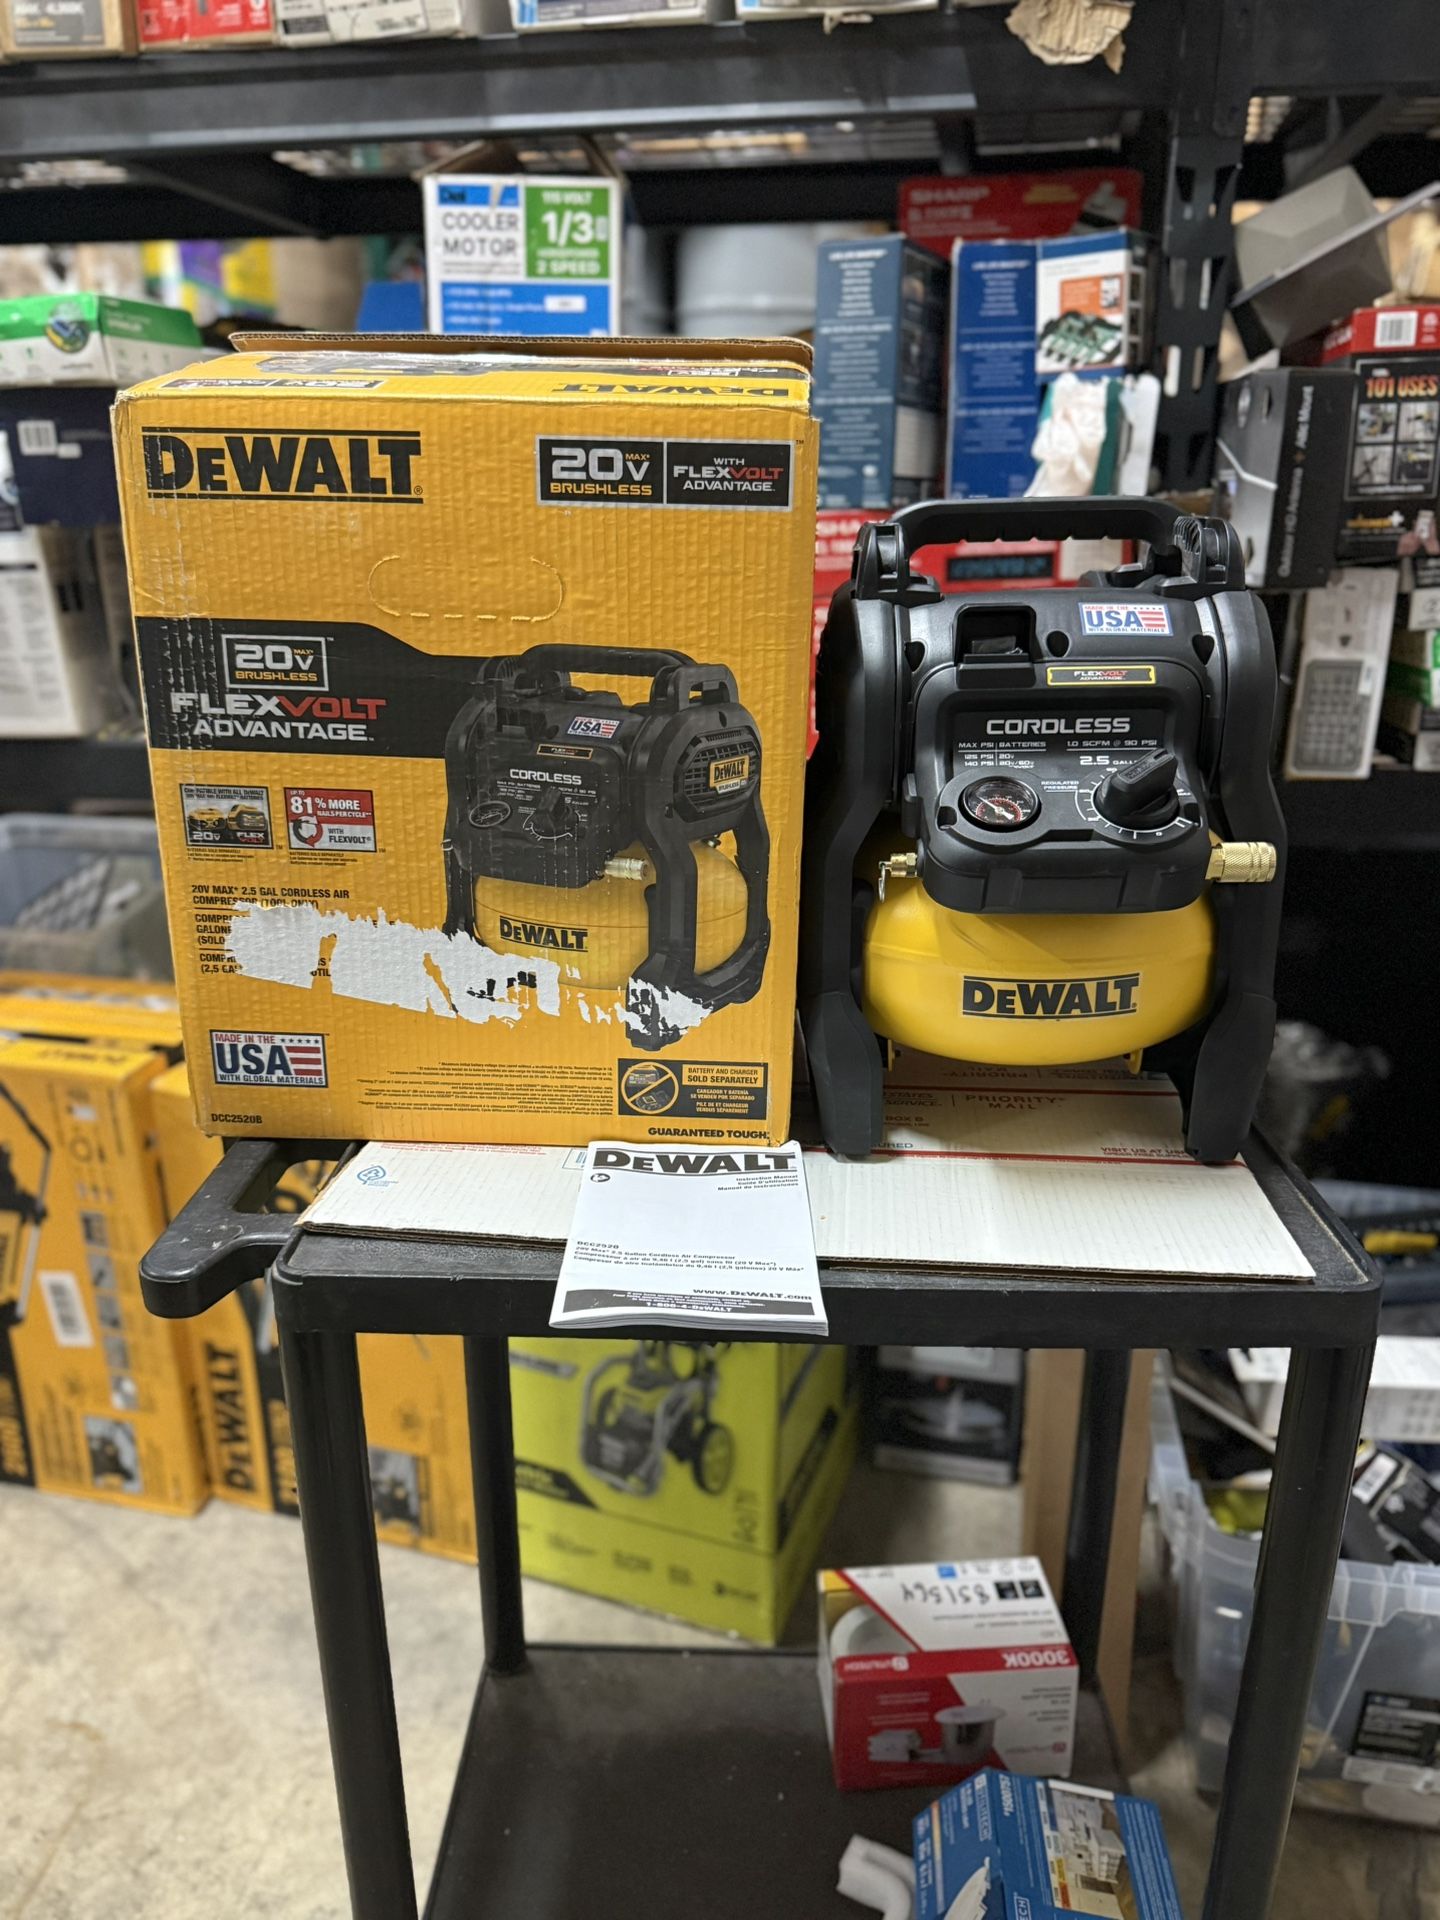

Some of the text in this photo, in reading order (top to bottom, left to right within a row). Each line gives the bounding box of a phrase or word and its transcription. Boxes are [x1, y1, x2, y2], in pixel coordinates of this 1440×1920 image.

[442, 211, 519, 231] COOLER
[541, 210, 594, 247] 1/3
[443, 237, 517, 256] MOTOR
[550, 261, 600, 276] SPEED
[1365, 374, 1440, 399] 101 USES
[1297, 386, 1314, 422] Mount
[713, 457, 745, 466] WITH
[673, 465, 784, 480] FLEXVOLT
[550, 482, 653, 496] BRUSHLESS
[1085, 610, 1144, 628] USA
[235, 671, 318, 682] BRUSHLESS
[170, 692, 387, 720] FLEXVOLT
[193, 718, 368, 741] ADVANTAGE
[571, 719, 602, 733] USA
[986, 717, 1132, 735] CORDLESS
[1079, 756, 1110, 766] 2.5
[509, 768, 582, 785] CORDLESS
[217, 788, 231, 796] WITH
[290, 796, 361, 814] 81 % MORE
[191, 885, 210, 894] 20V
[241, 887, 257, 896] 2.5
[259, 887, 278, 897] GAL
[281, 888, 331, 898] CORDLESS
[333, 889, 350, 899] AIR
[215, 1033, 276, 1044] MADE IN THE
[216, 1043, 293, 1075] USA
[243, 1075, 275, 1083] GLOBAL
[277, 1076, 324, 1085] MATERIALS
[710, 1076, 759, 1084] SEPARATELY
[966, 1094, 1057, 1104] PRIORITY
[989, 1102, 1038, 1110] MAIL
[211, 1113, 263, 1124] DCC2520B
[647, 1127, 725, 1138] GUARANTEED
[577, 1241, 620, 1249] DCC2520
[1004, 1650, 1071, 1668] 3000K
